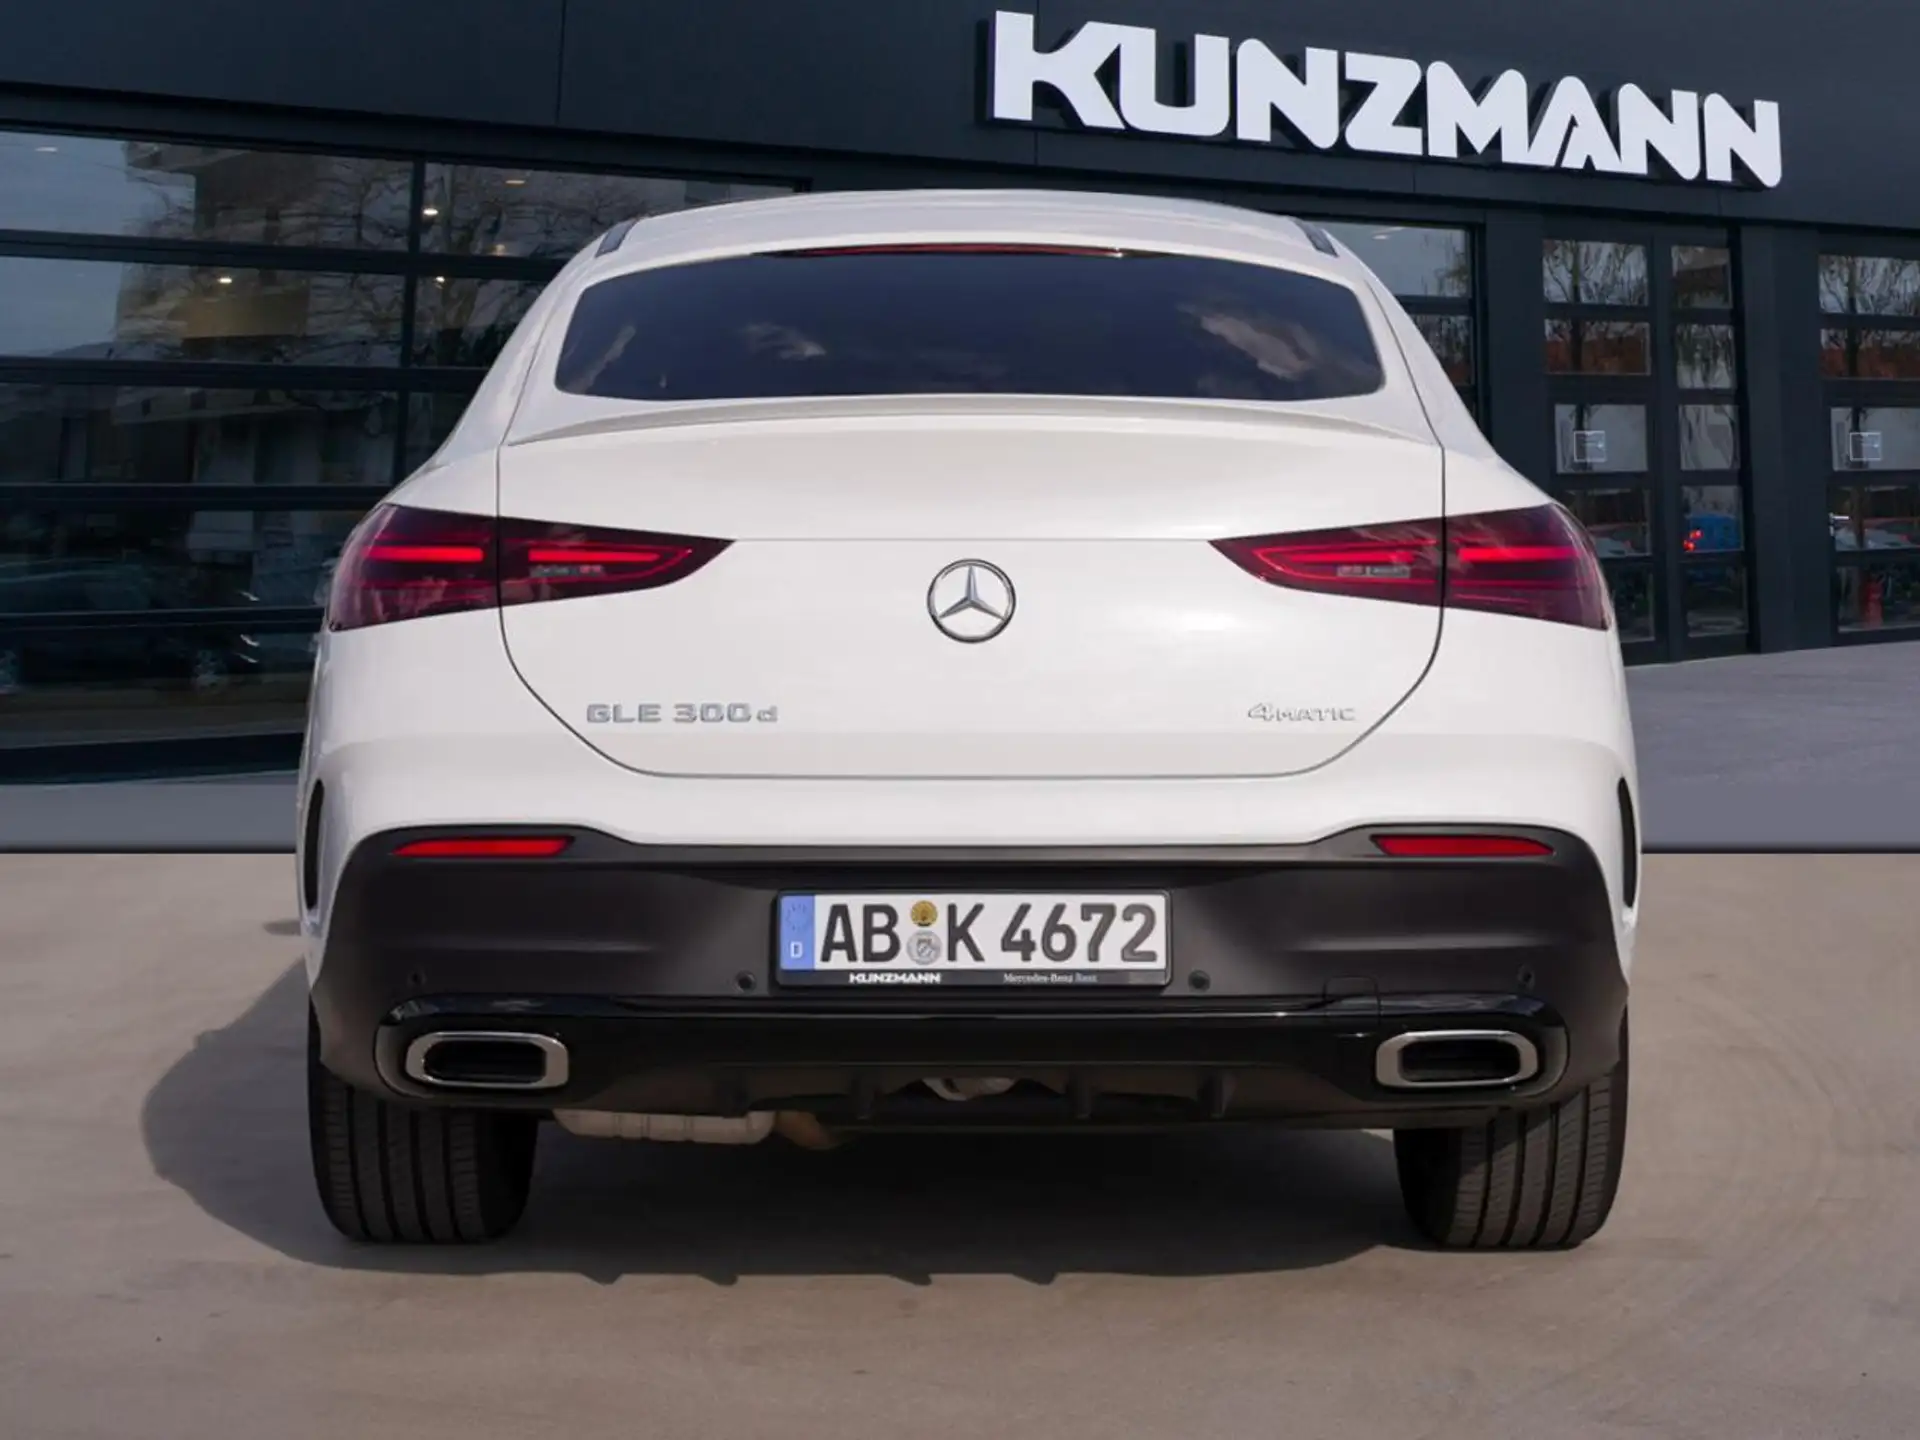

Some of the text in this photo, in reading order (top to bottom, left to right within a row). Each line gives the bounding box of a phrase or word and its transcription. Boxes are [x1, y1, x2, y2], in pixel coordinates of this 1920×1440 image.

[992, 11, 1782, 188] KUNZMANN
[586, 703, 662, 723] GLE
[1247, 702, 1356, 721] 4MATIC
[821, 903, 1157, 962] AB K 4672
[790, 941, 802, 958] D
[849, 972, 941, 984] KUNZMANN
[1003, 972, 1073, 984] Mercedes-Benz
